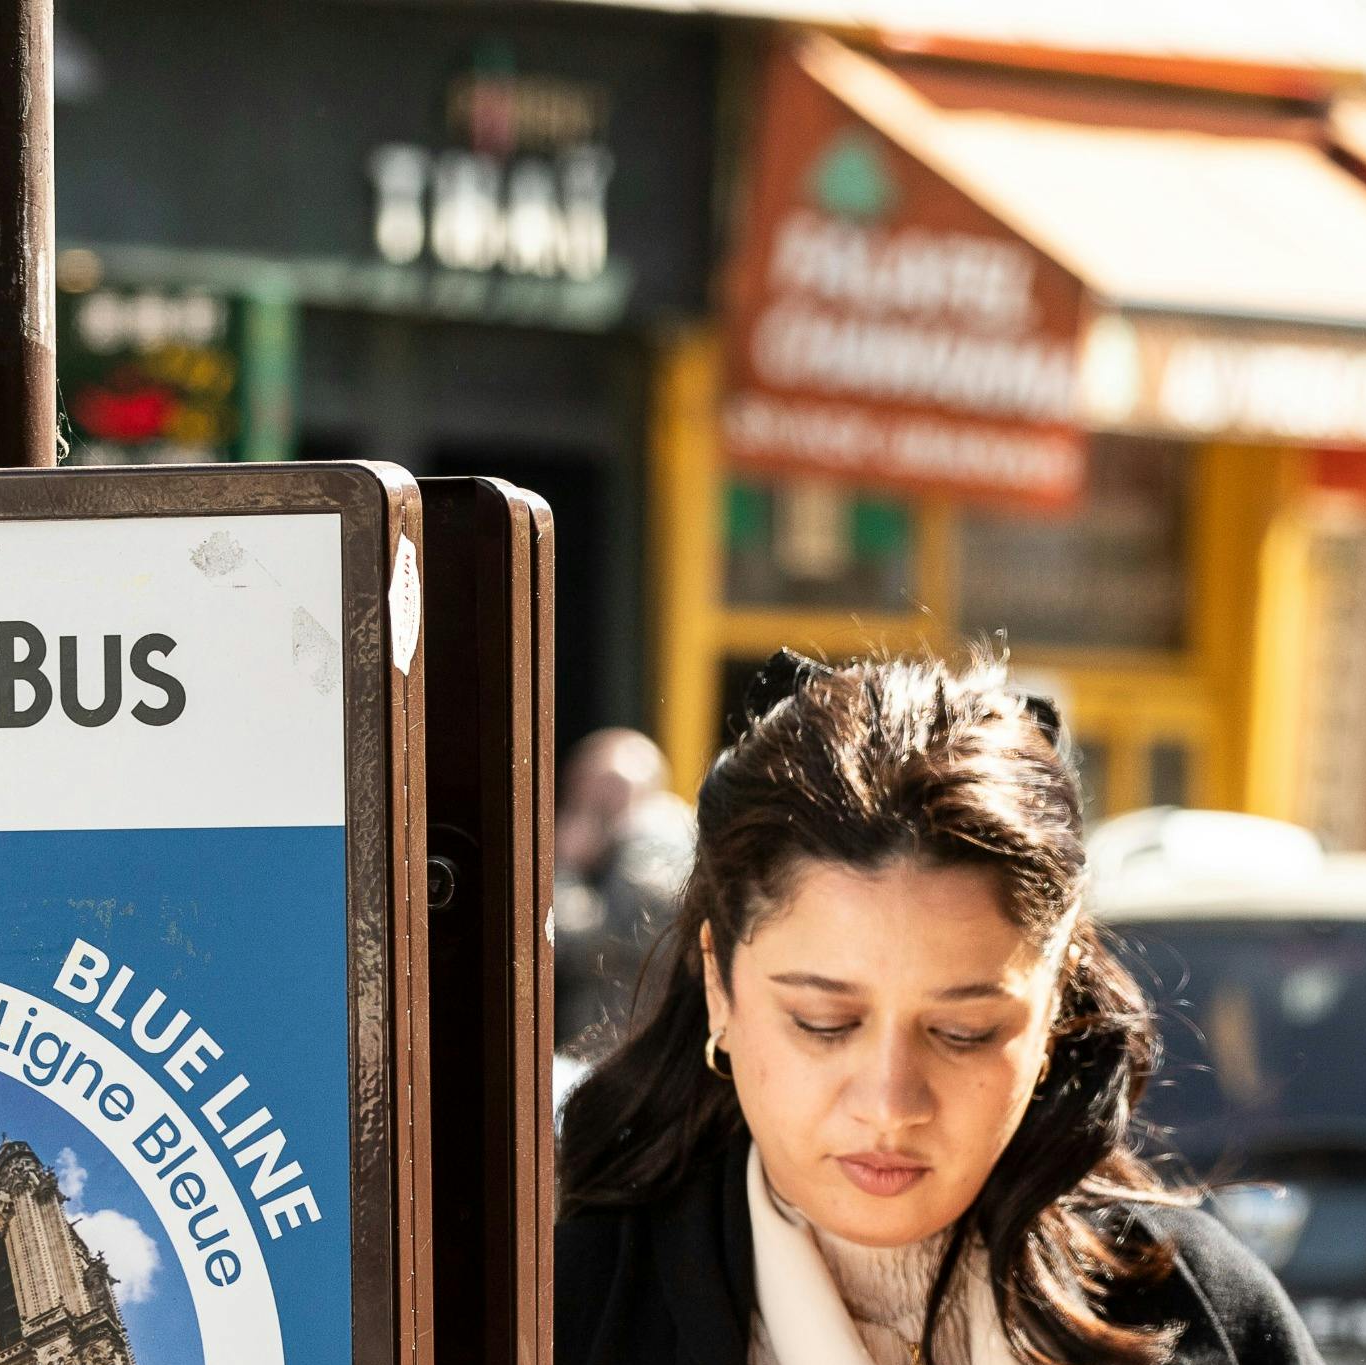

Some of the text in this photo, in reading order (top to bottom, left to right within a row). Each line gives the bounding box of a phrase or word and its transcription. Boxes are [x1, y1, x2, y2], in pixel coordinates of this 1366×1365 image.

[52, 937, 323, 1240] BLUE LINE
[131, 1112, 242, 1287] Bleue
